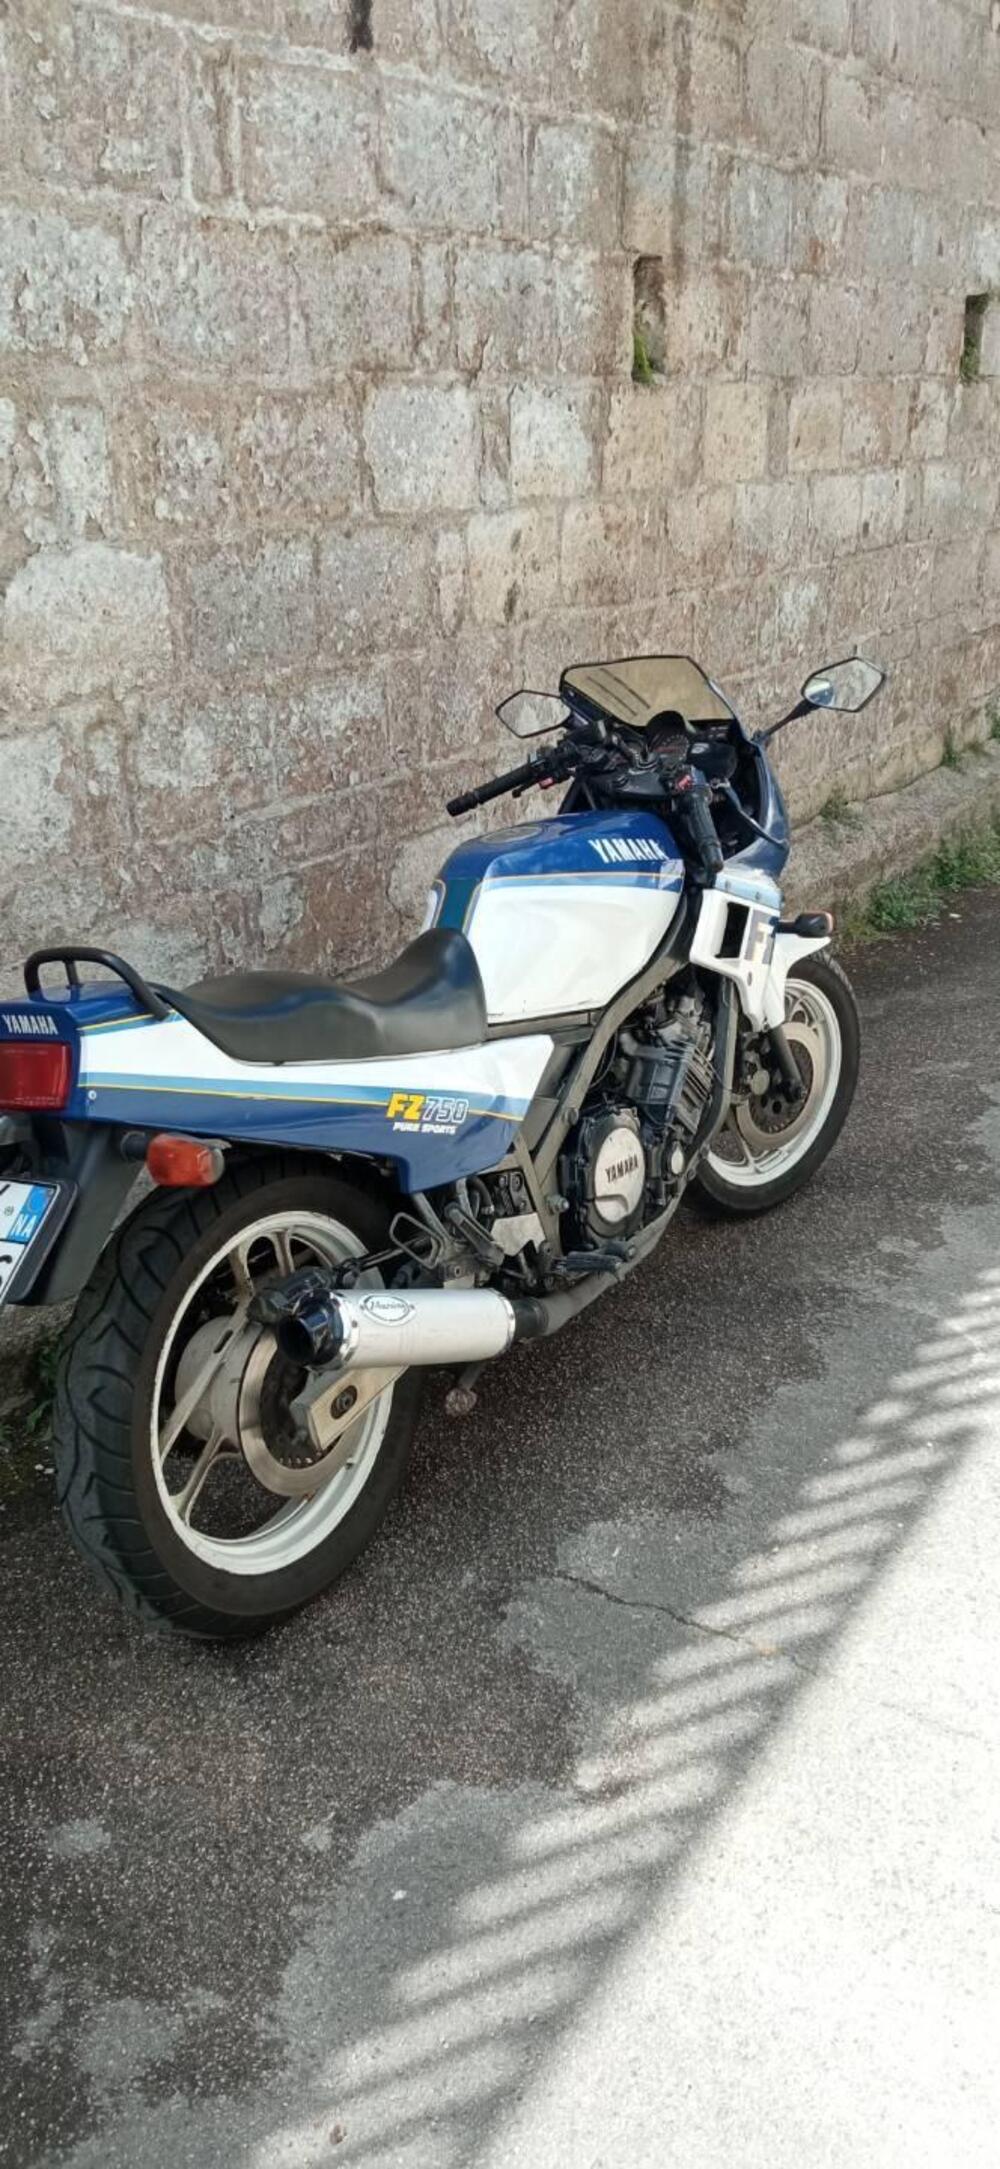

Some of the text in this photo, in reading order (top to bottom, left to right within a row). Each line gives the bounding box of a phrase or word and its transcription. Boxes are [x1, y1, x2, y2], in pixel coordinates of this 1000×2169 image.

[588, 838, 669, 863] YAMAHA
[1, 1014, 59, 1035] YAMAHA
[392, 1121, 457, 1135] PURE SPORTS
[604, 1154, 638, 1184] YAMAHA
[9, 1213, 38, 1238] NA
